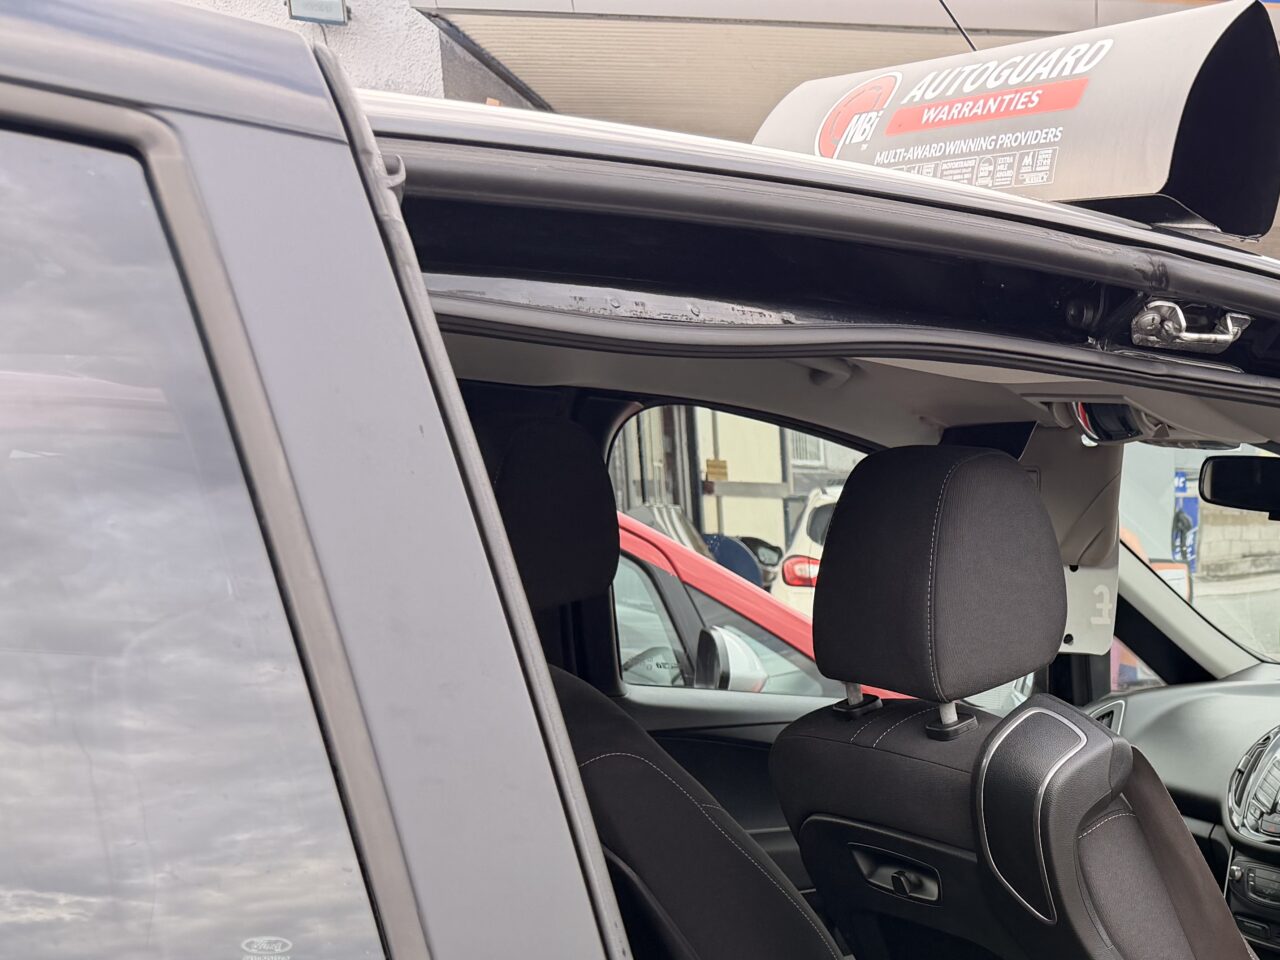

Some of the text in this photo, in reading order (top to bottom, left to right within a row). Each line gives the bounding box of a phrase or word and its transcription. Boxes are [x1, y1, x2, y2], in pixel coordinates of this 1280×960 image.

[902, 38, 1115, 104] AUTOGUARD
[920, 91, 1043, 125] WARRANTIES
[874, 127, 1064, 166] MULTI-AWARD WINNING PROVIDERS
